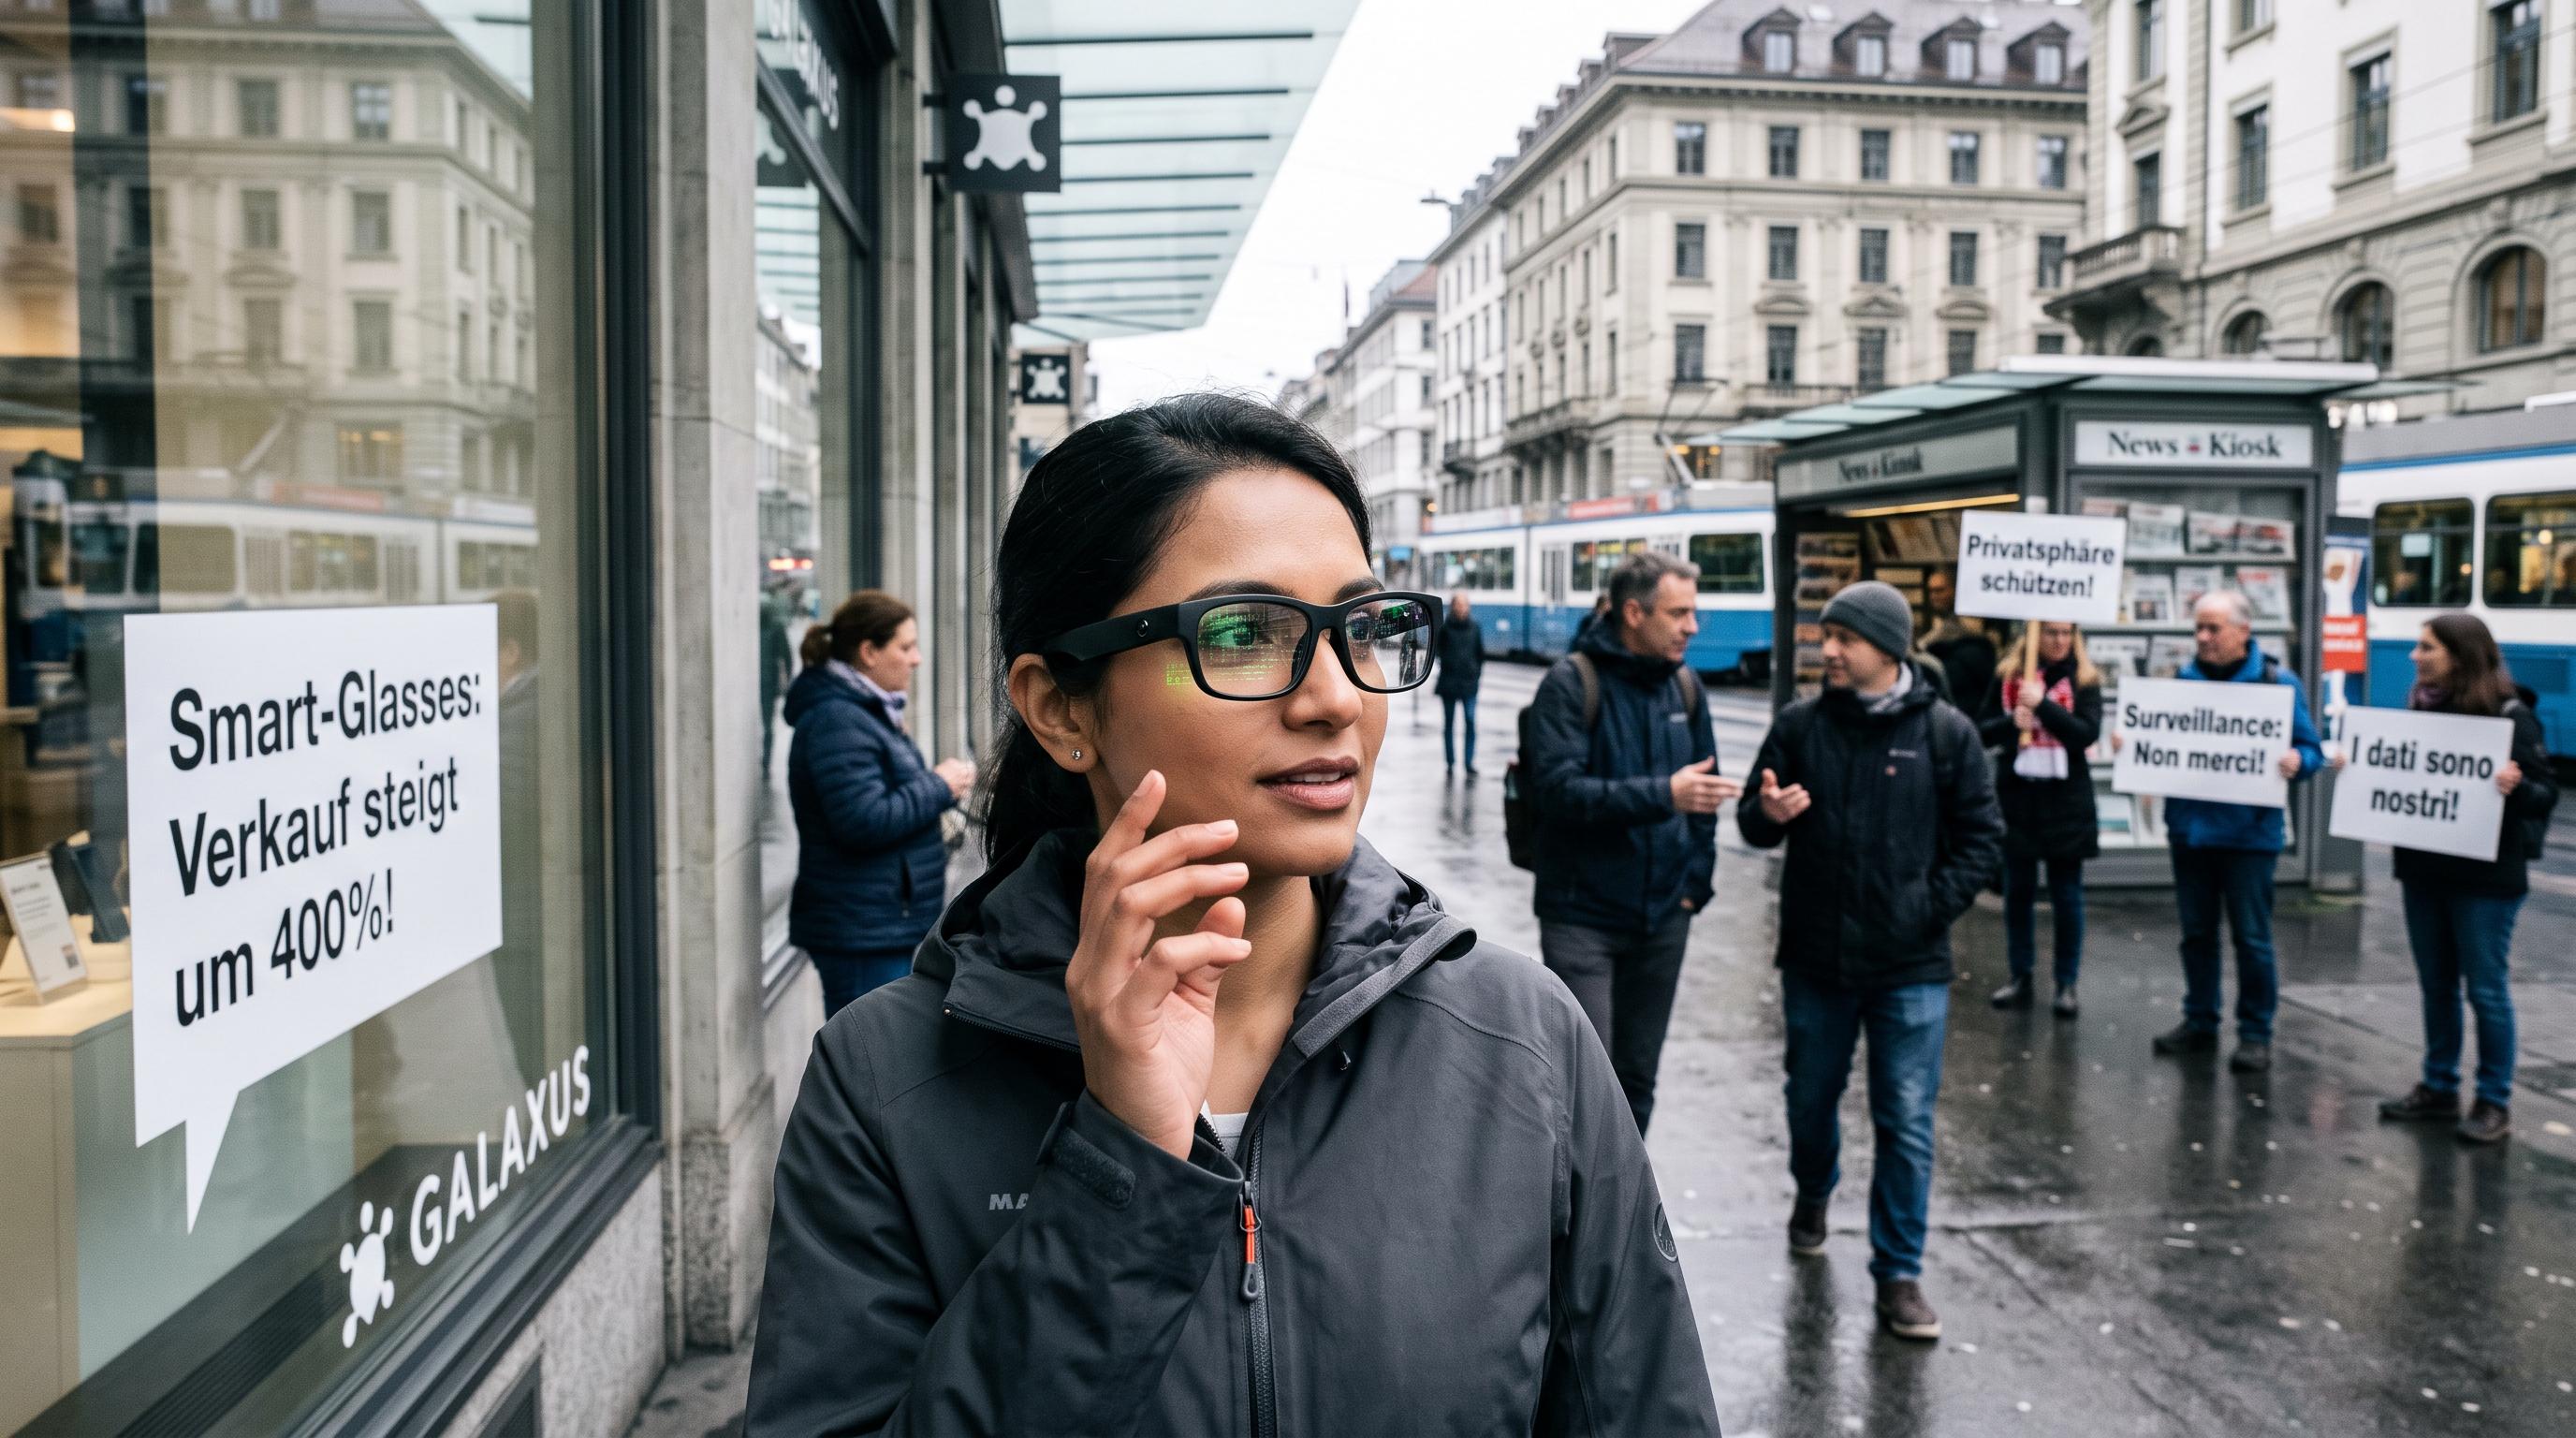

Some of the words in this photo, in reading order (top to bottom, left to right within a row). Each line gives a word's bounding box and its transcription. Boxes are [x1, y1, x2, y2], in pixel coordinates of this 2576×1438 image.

[2108, 430, 2179, 456] News
[2209, 433, 2281, 457] Kiosk
[1966, 534, 2115, 565] Privatsphäre
[1980, 572, 2094, 597] schützen!
[169, 669, 481, 771] Smart-Glasses:
[2123, 703, 2283, 739] Surveillance:
[2134, 741, 2180, 768] Non
[2188, 748, 2266, 775] merci!
[2350, 735, 2360, 765] I
[2366, 738, 2418, 771] dati
[2424, 751, 2495, 781] sono
[2370, 788, 2460, 823] nostri!
[168, 777, 351, 897] Verkauf
[363, 756, 458, 838] steigt
[175, 942, 254, 1027] um
[270, 867, 394, 980] 400%!
[409, 1045, 592, 1266] GALAXUS
